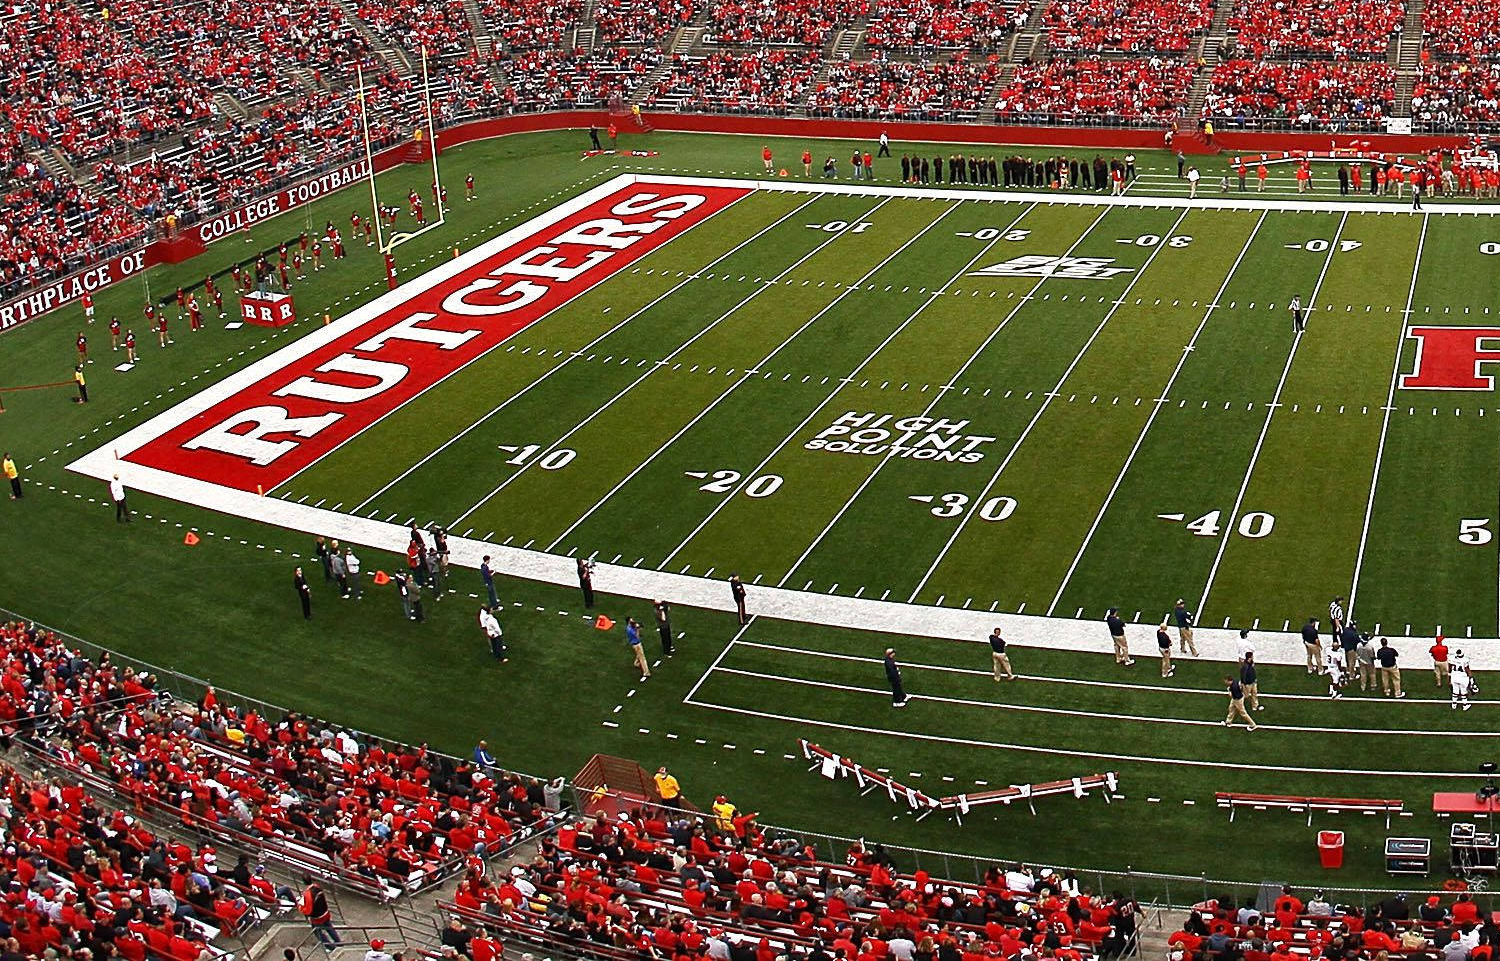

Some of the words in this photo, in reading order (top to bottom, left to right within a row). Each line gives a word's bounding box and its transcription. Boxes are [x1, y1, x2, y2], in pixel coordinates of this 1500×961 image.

[200, 195, 280, 241] COLLEGE
[288, 160, 372, 207] FOOTBALL
[120, 249, 147, 279] OF
[979, 262, 1136, 277] EAST
[1005, 254, 1116, 269] BIG
[242, 304, 256, 317] R
[260, 306, 274, 322] R
[279, 302, 293, 320] R
[181, 192, 709, 470] RUTGERS
[831, 411, 970, 435] HIGH
[803, 438, 985, 463] SOLUTIONS
[814, 425, 997, 452] POINT
[505, 444, 578, 470] 10
[699, 470, 785, 498] 20
[930, 492, 1019, 522] 30
[1185, 510, 1276, 539] 40
